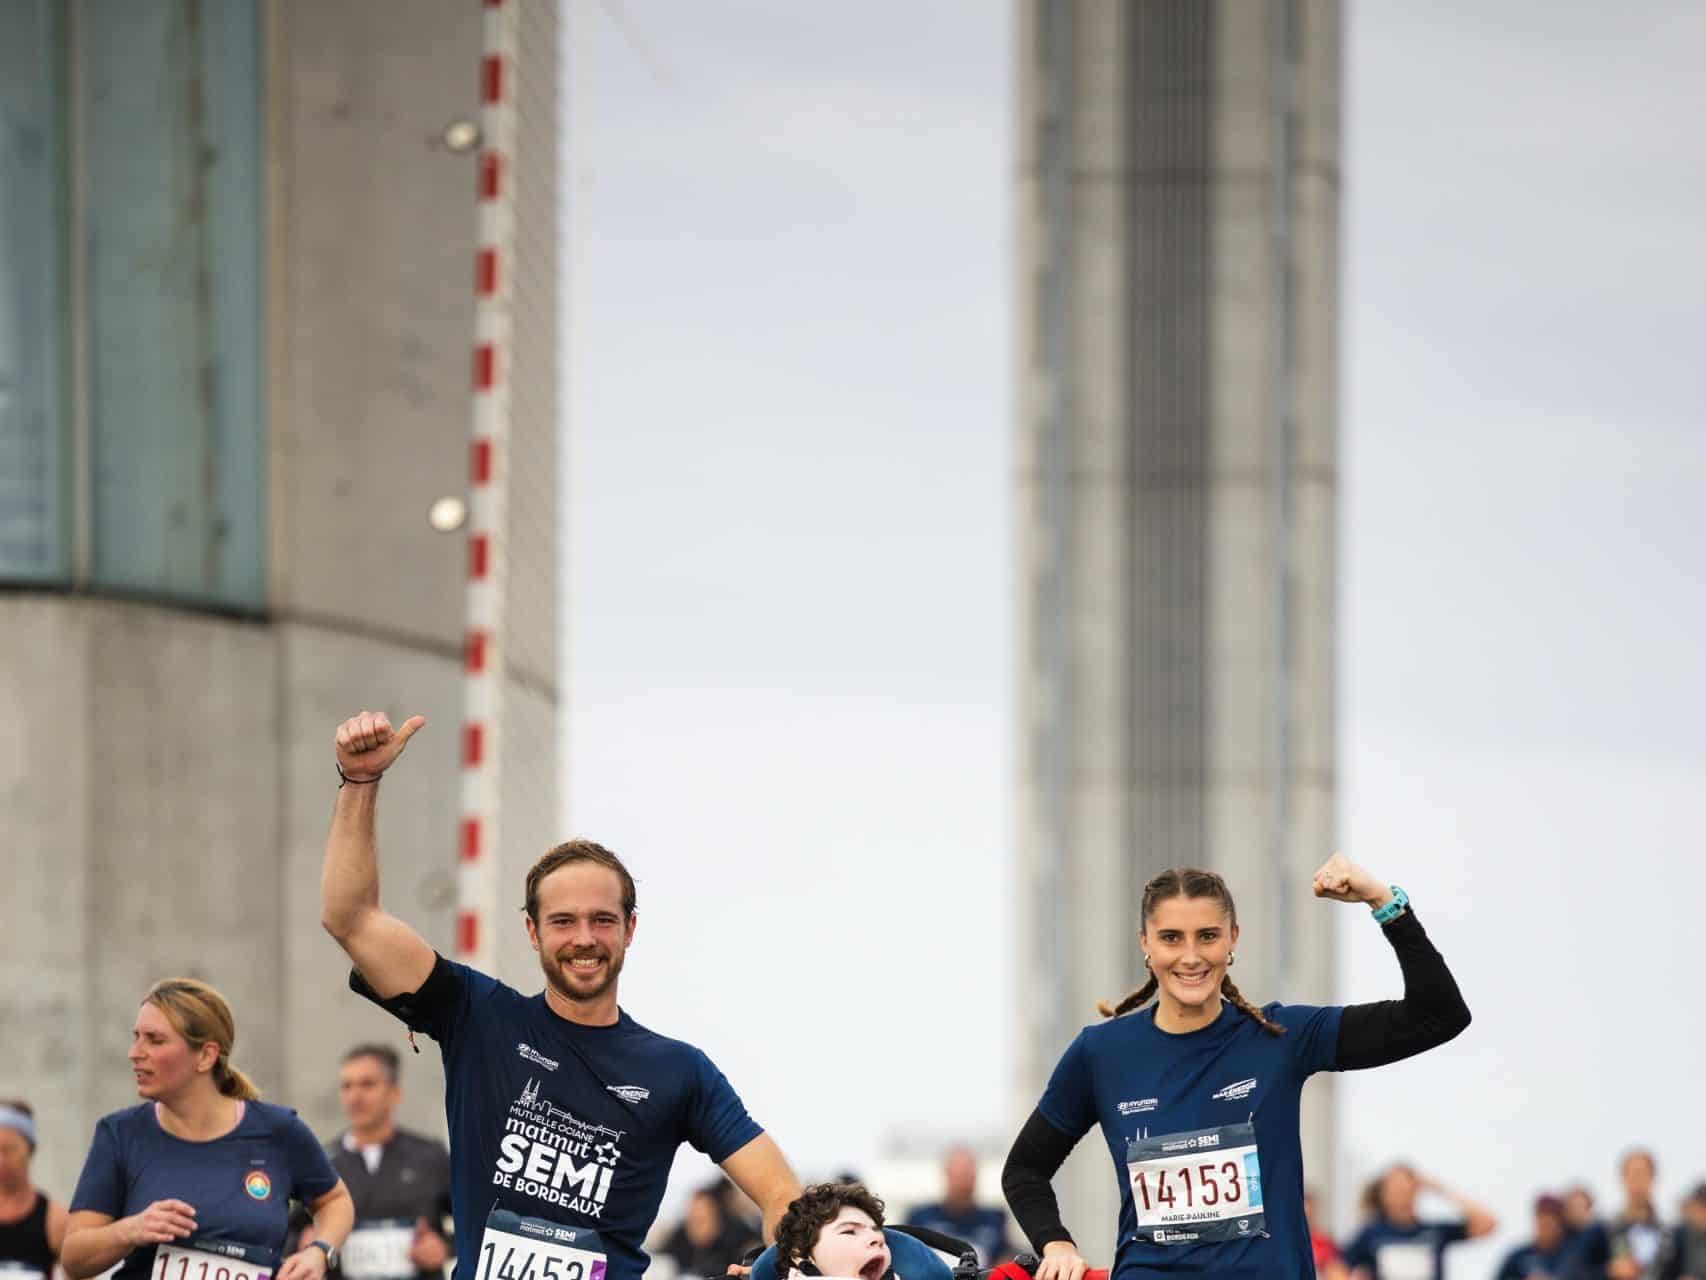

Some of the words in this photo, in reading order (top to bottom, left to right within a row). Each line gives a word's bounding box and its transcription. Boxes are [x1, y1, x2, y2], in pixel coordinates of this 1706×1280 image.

[505, 1117, 591, 1158] matmut
[510, 1106, 557, 1128] MUTUELLE
[558, 1124, 594, 1143] OCIANE
[1198, 1134, 1219, 1145] SEMI
[496, 1134, 613, 1203] SEMI
[1134, 1161, 1241, 1210] 14153
[493, 1171, 512, 1188] DE
[515, 1178, 603, 1218] BORDEAUX
[555, 1228, 576, 1240] SEMI
